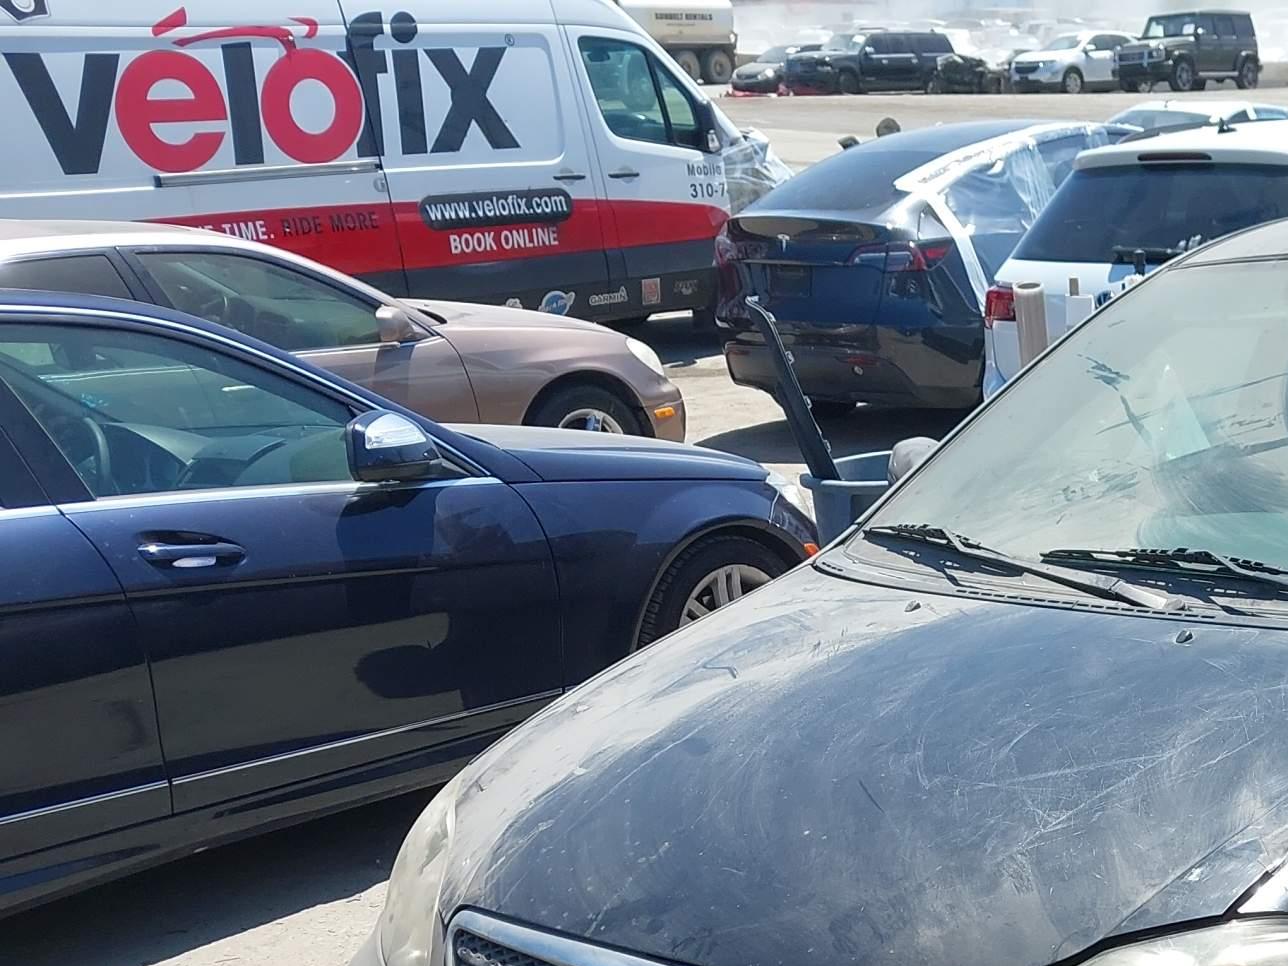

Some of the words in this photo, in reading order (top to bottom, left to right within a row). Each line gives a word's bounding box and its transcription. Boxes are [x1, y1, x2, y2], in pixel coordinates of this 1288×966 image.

[425, 195, 568, 221] www.velofix.com
[280, 216, 322, 237] RIDE
[331, 211, 379, 232] MORE
[450, 231, 497, 254] BOOK
[500, 227, 559, 250] ONLINE
